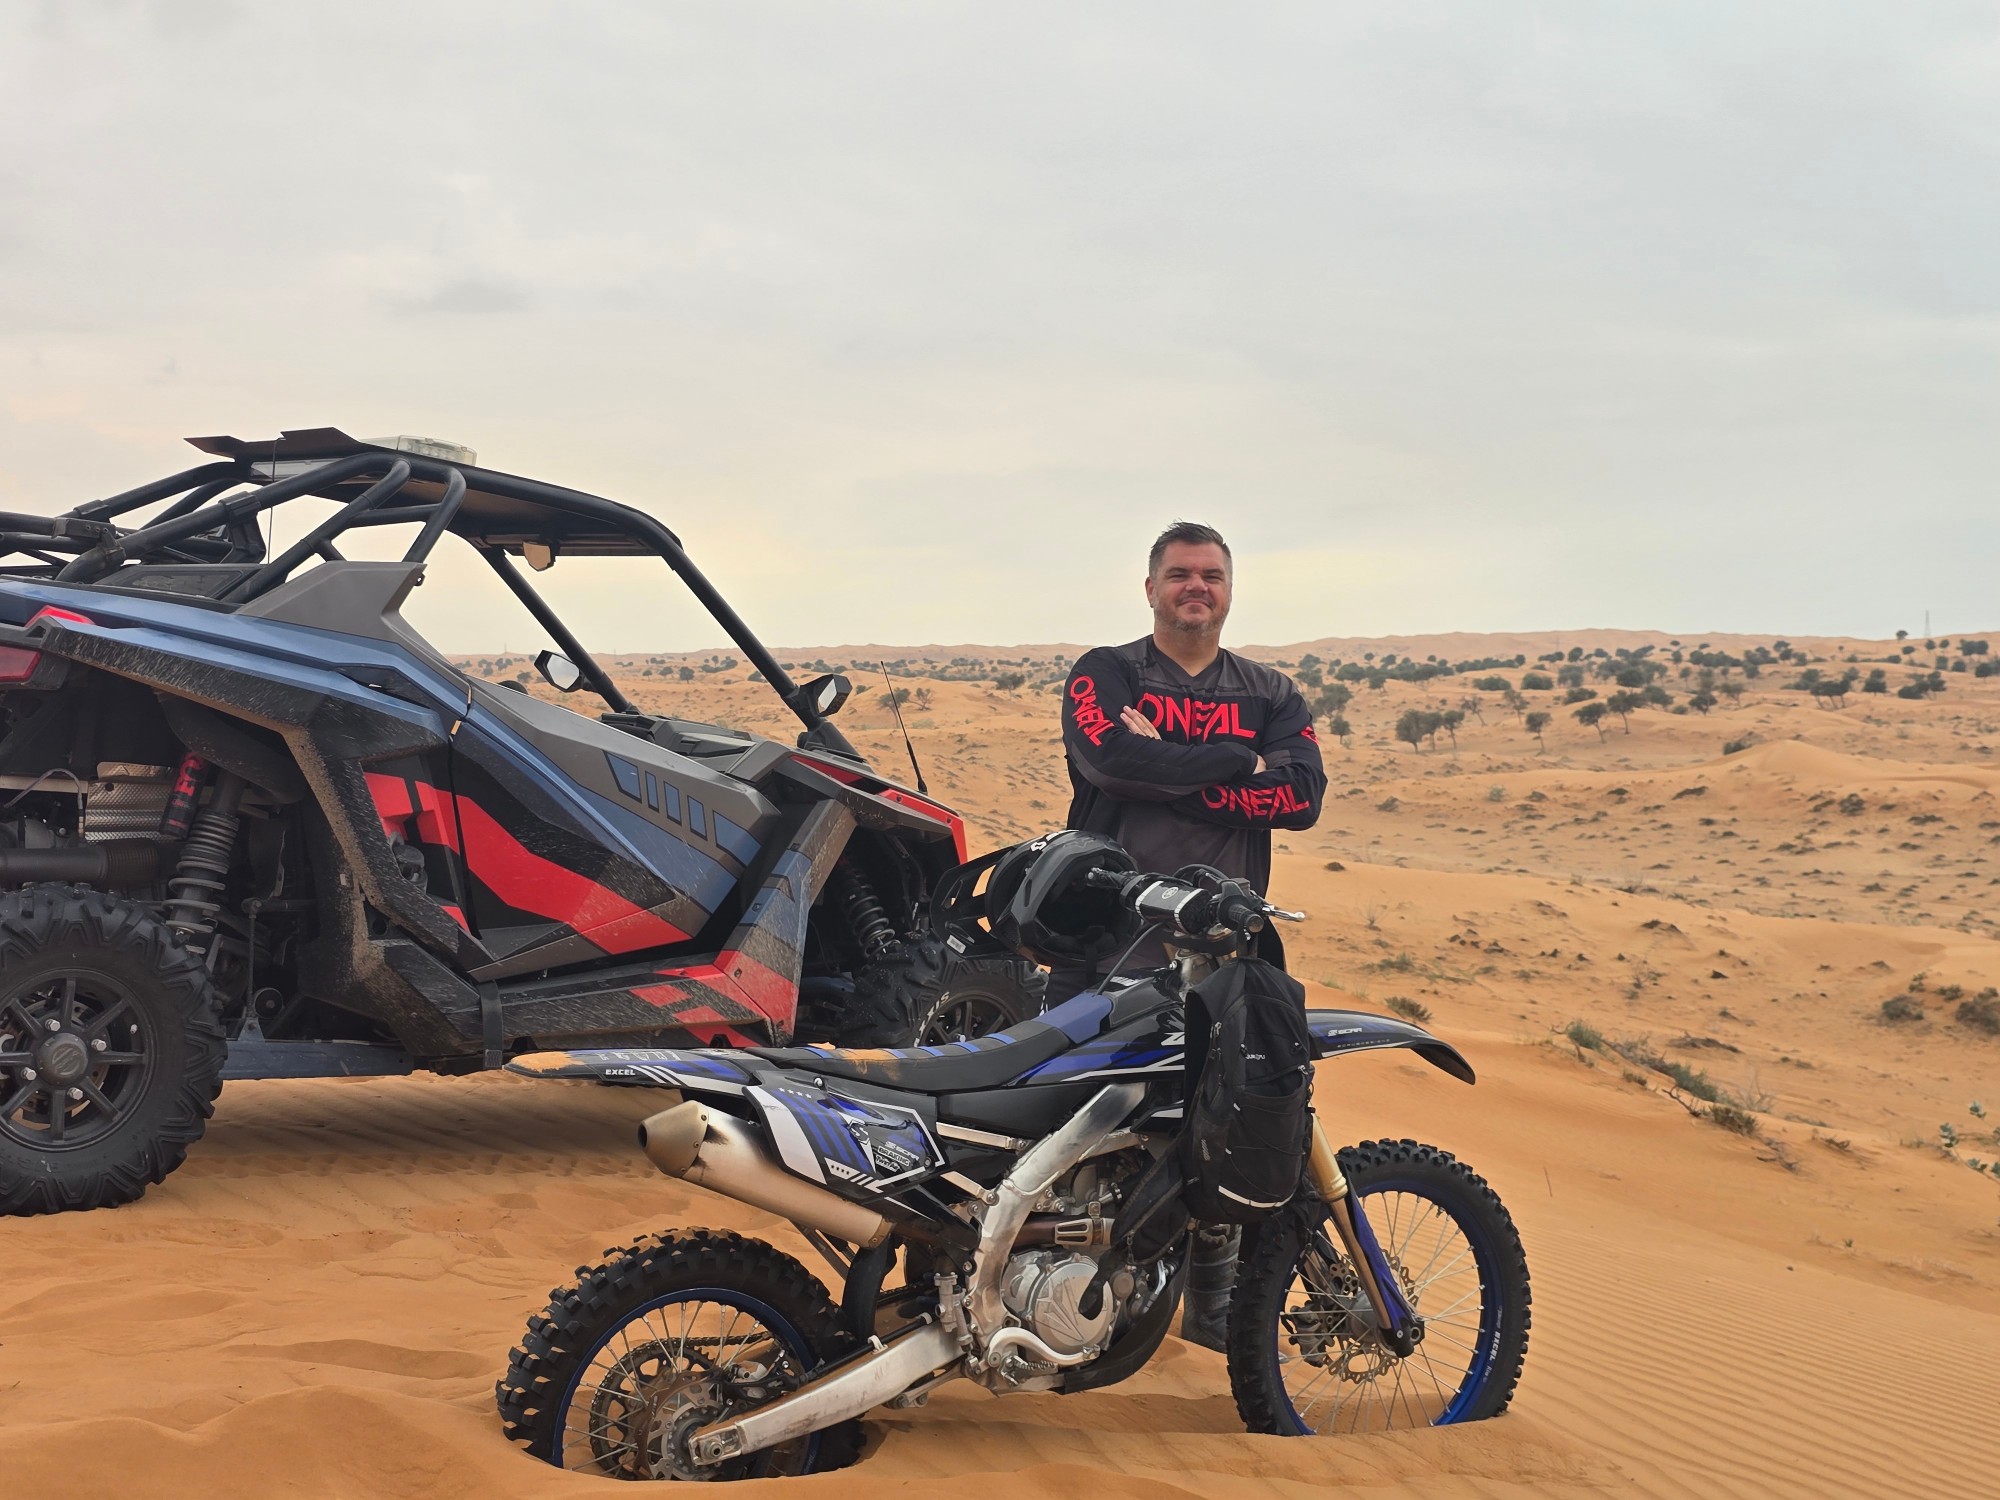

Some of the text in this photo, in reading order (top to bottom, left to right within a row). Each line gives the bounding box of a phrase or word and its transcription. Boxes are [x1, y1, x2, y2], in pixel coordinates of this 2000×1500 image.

[605, 1068, 636, 1076] EXCEL
[878, 1148, 910, 1166] BRAKING
[1489, 1331, 1501, 1361] EXCEL
